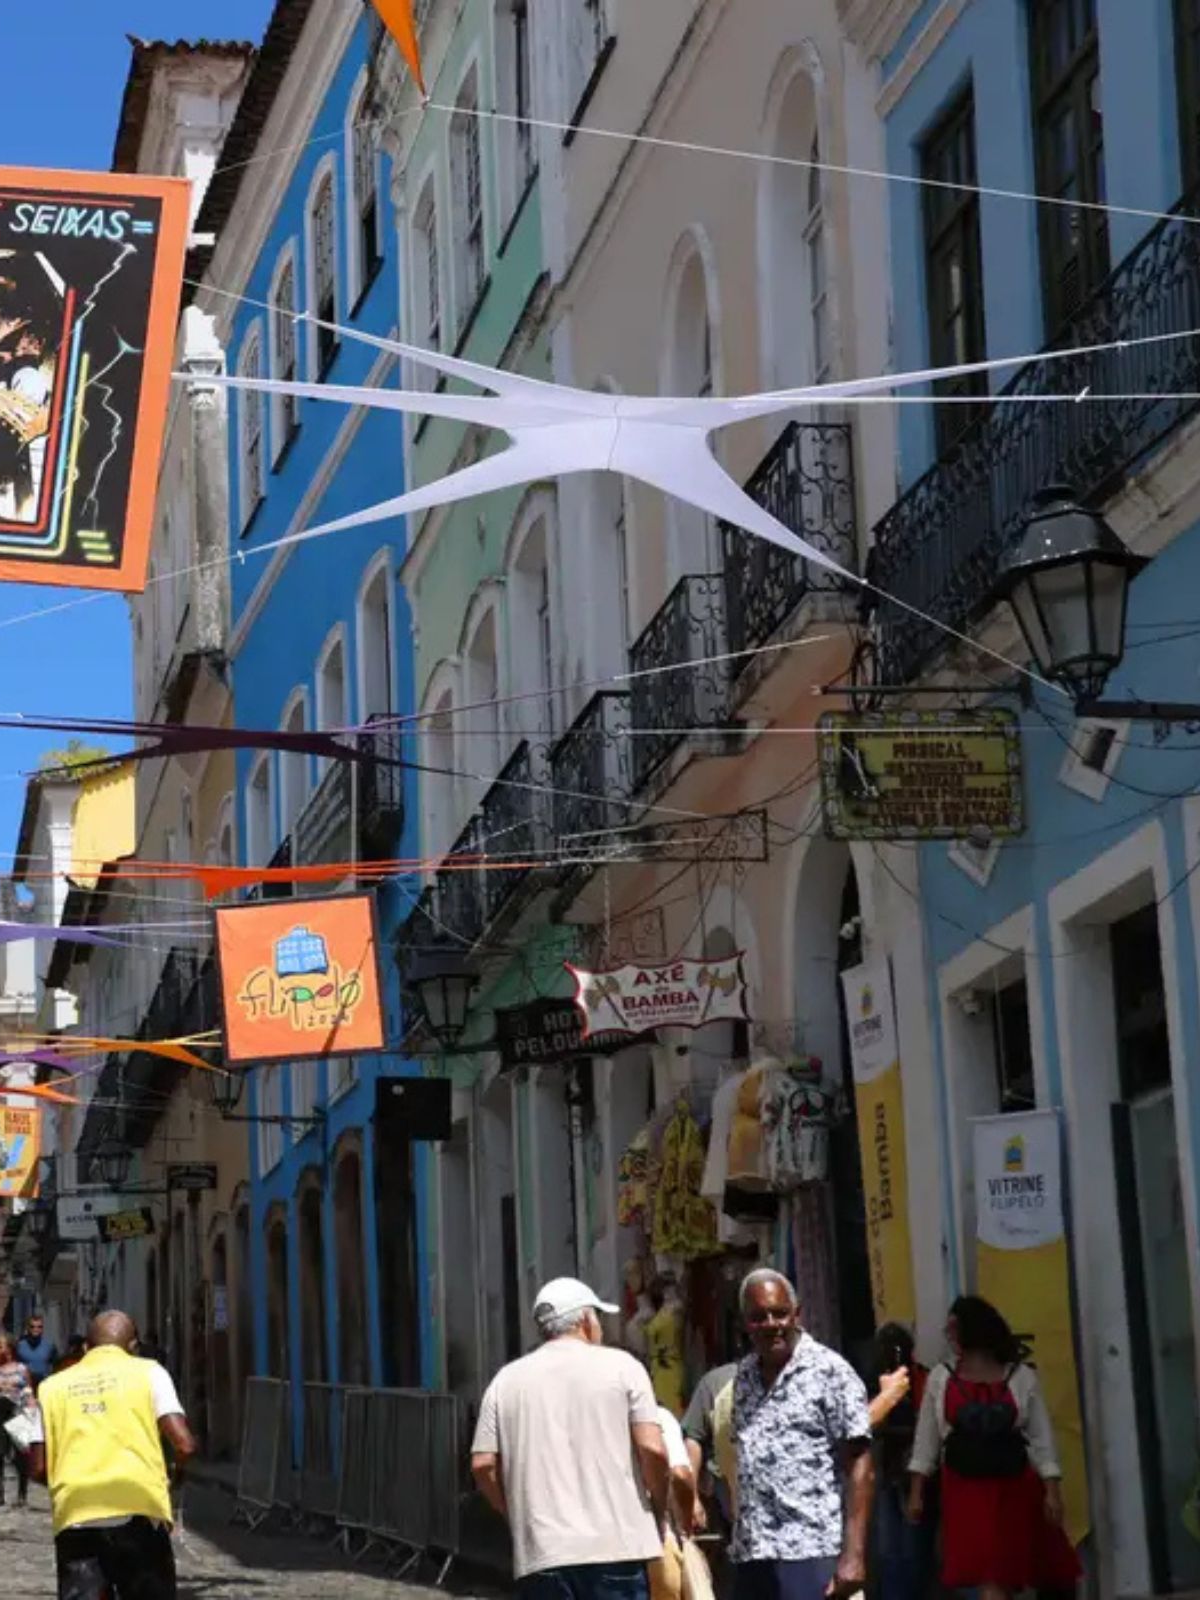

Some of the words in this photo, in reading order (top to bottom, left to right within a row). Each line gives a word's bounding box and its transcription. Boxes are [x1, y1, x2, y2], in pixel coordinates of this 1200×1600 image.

[8, 203, 131, 240] SEIXAS
[622, 991, 699, 1010] BAMBA
[874, 1102, 893, 1221] Bamba
[987, 1174, 1045, 1196] VITRINE
